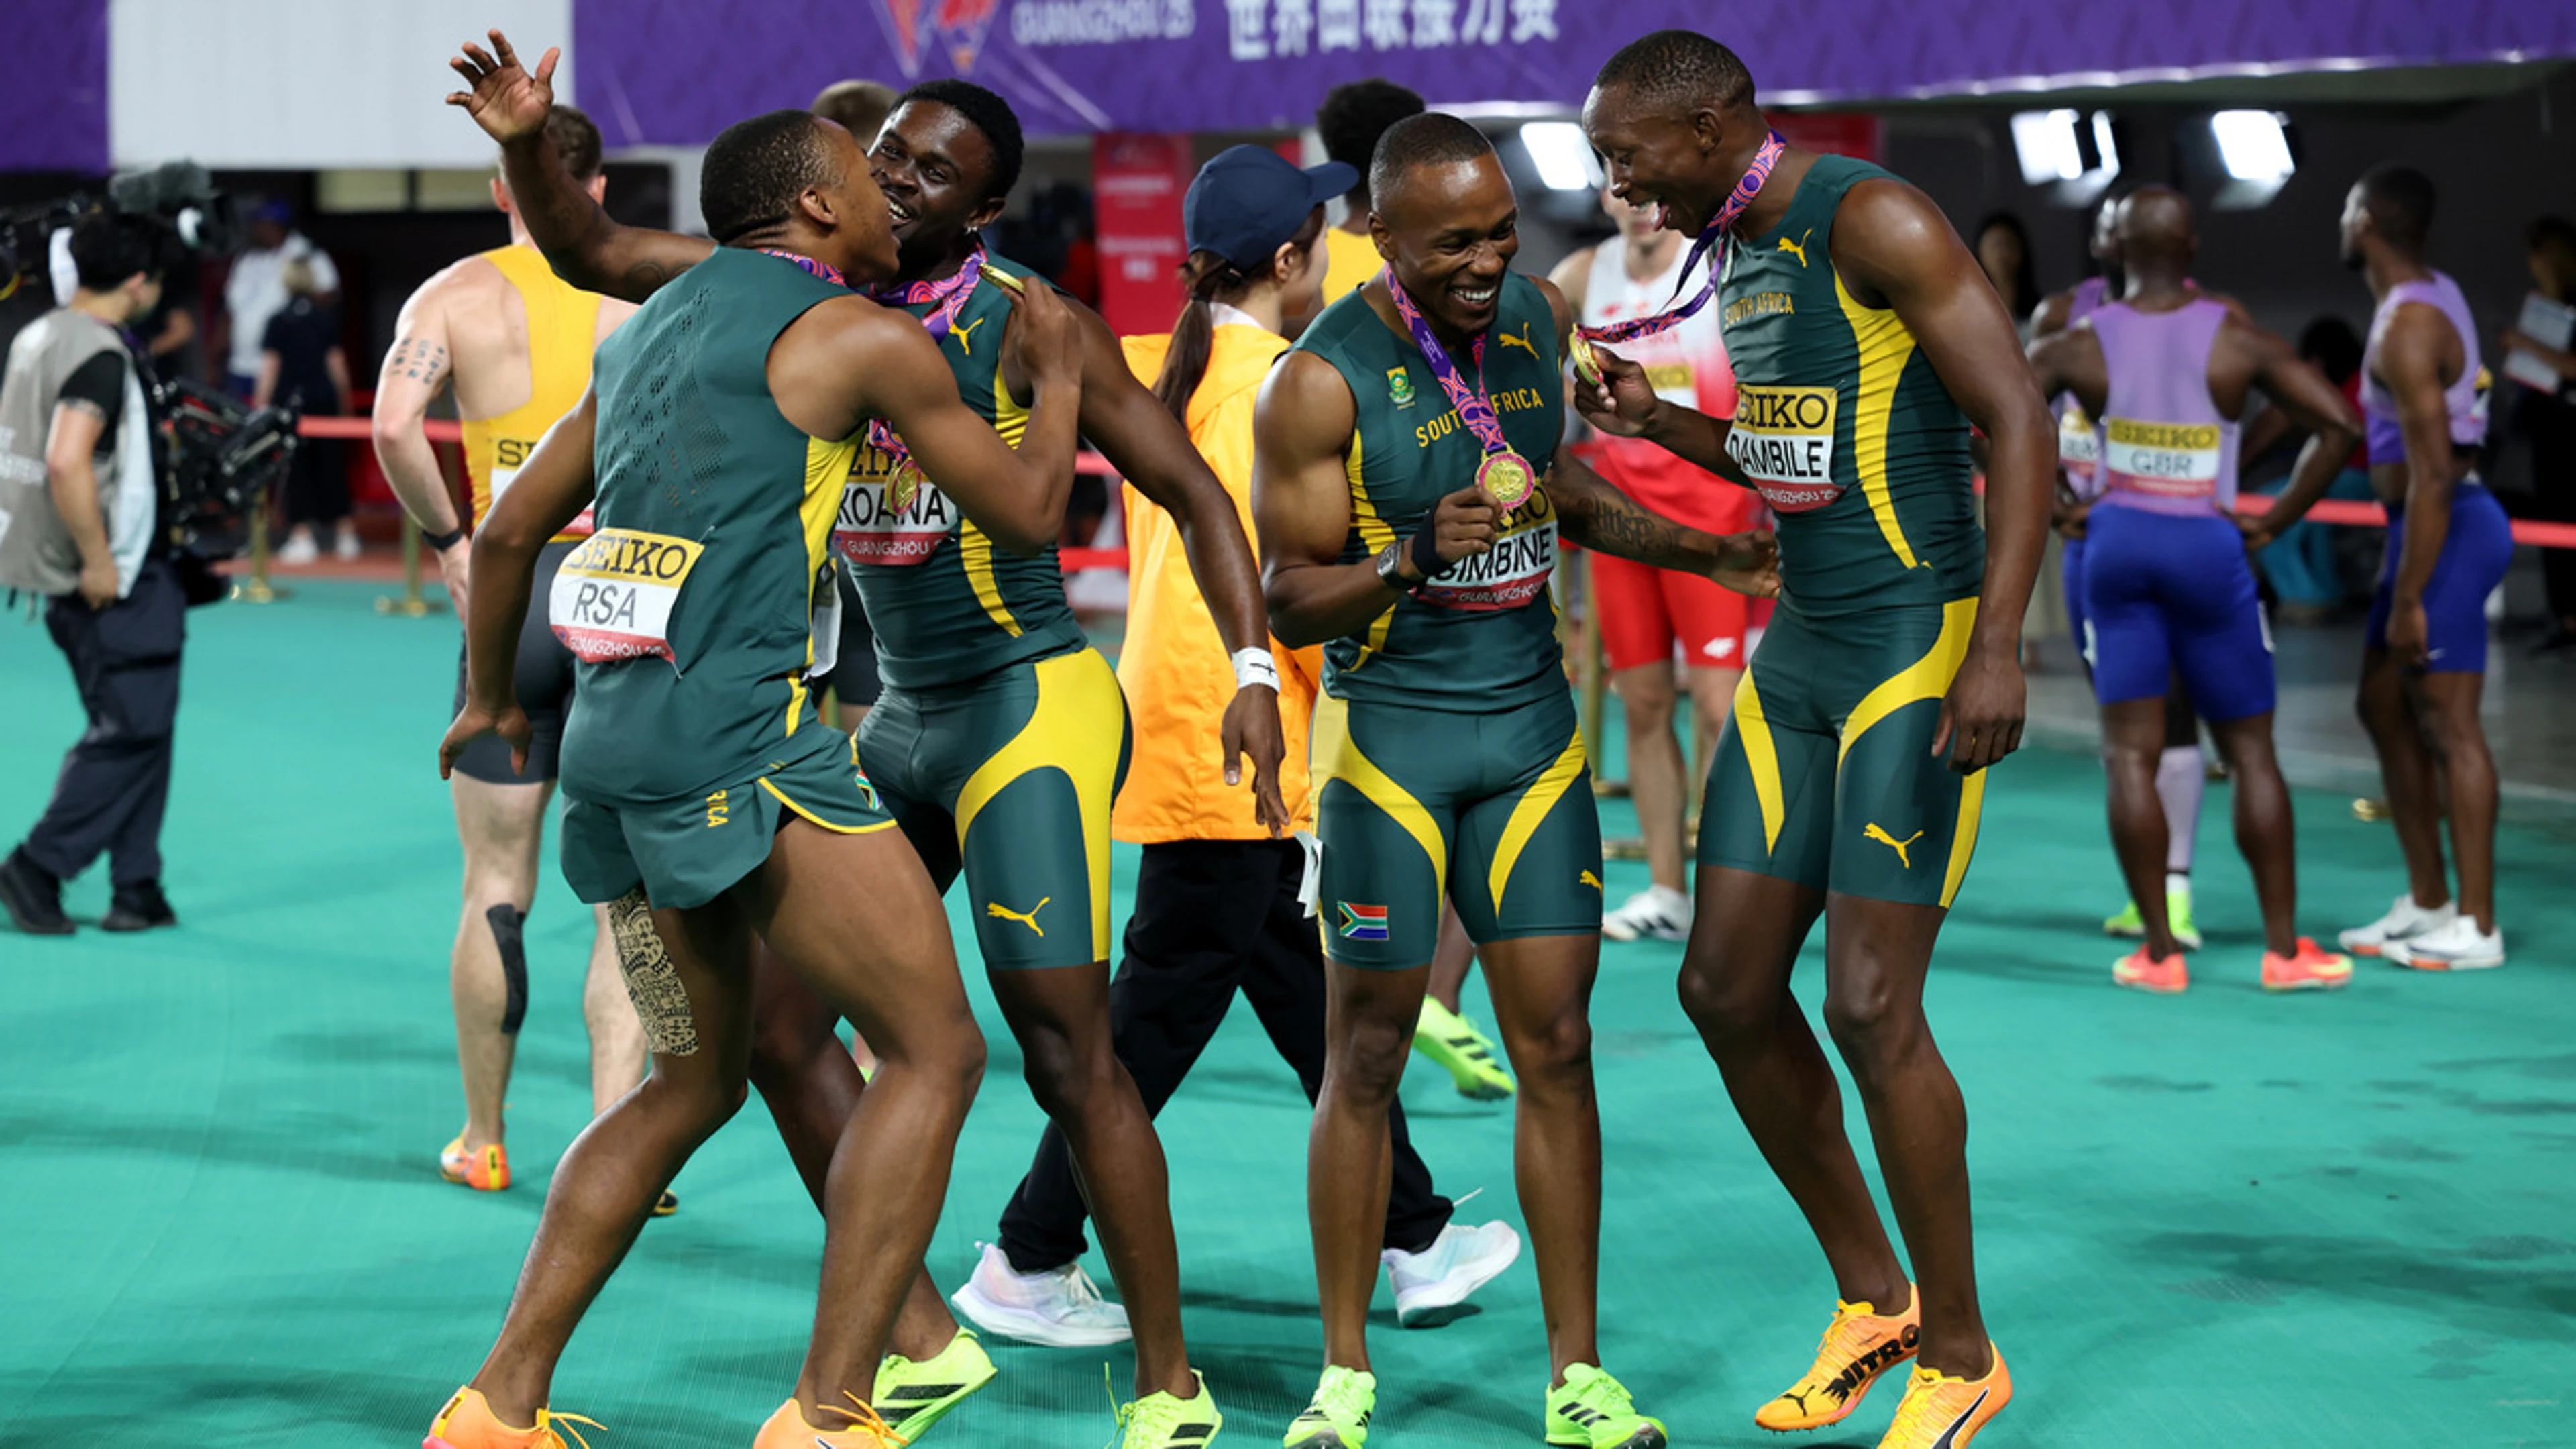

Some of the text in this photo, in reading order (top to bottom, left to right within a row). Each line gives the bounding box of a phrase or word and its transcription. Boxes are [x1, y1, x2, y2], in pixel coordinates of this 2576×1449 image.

[1724, 296, 1754, 329] SOUTH
[1756, 291, 1795, 315] AFRICA
[1415, 388, 1544, 447] SOUT FRICA
[2111, 422, 2212, 449] SEIKO
[2131, 450, 2192, 474] GBR
[565, 535, 688, 580] SEIKO
[847, 540, 930, 556] GUANGZHOU
[572, 582, 637, 628] RSA
[1821, 1324, 1920, 1409] NITRO
